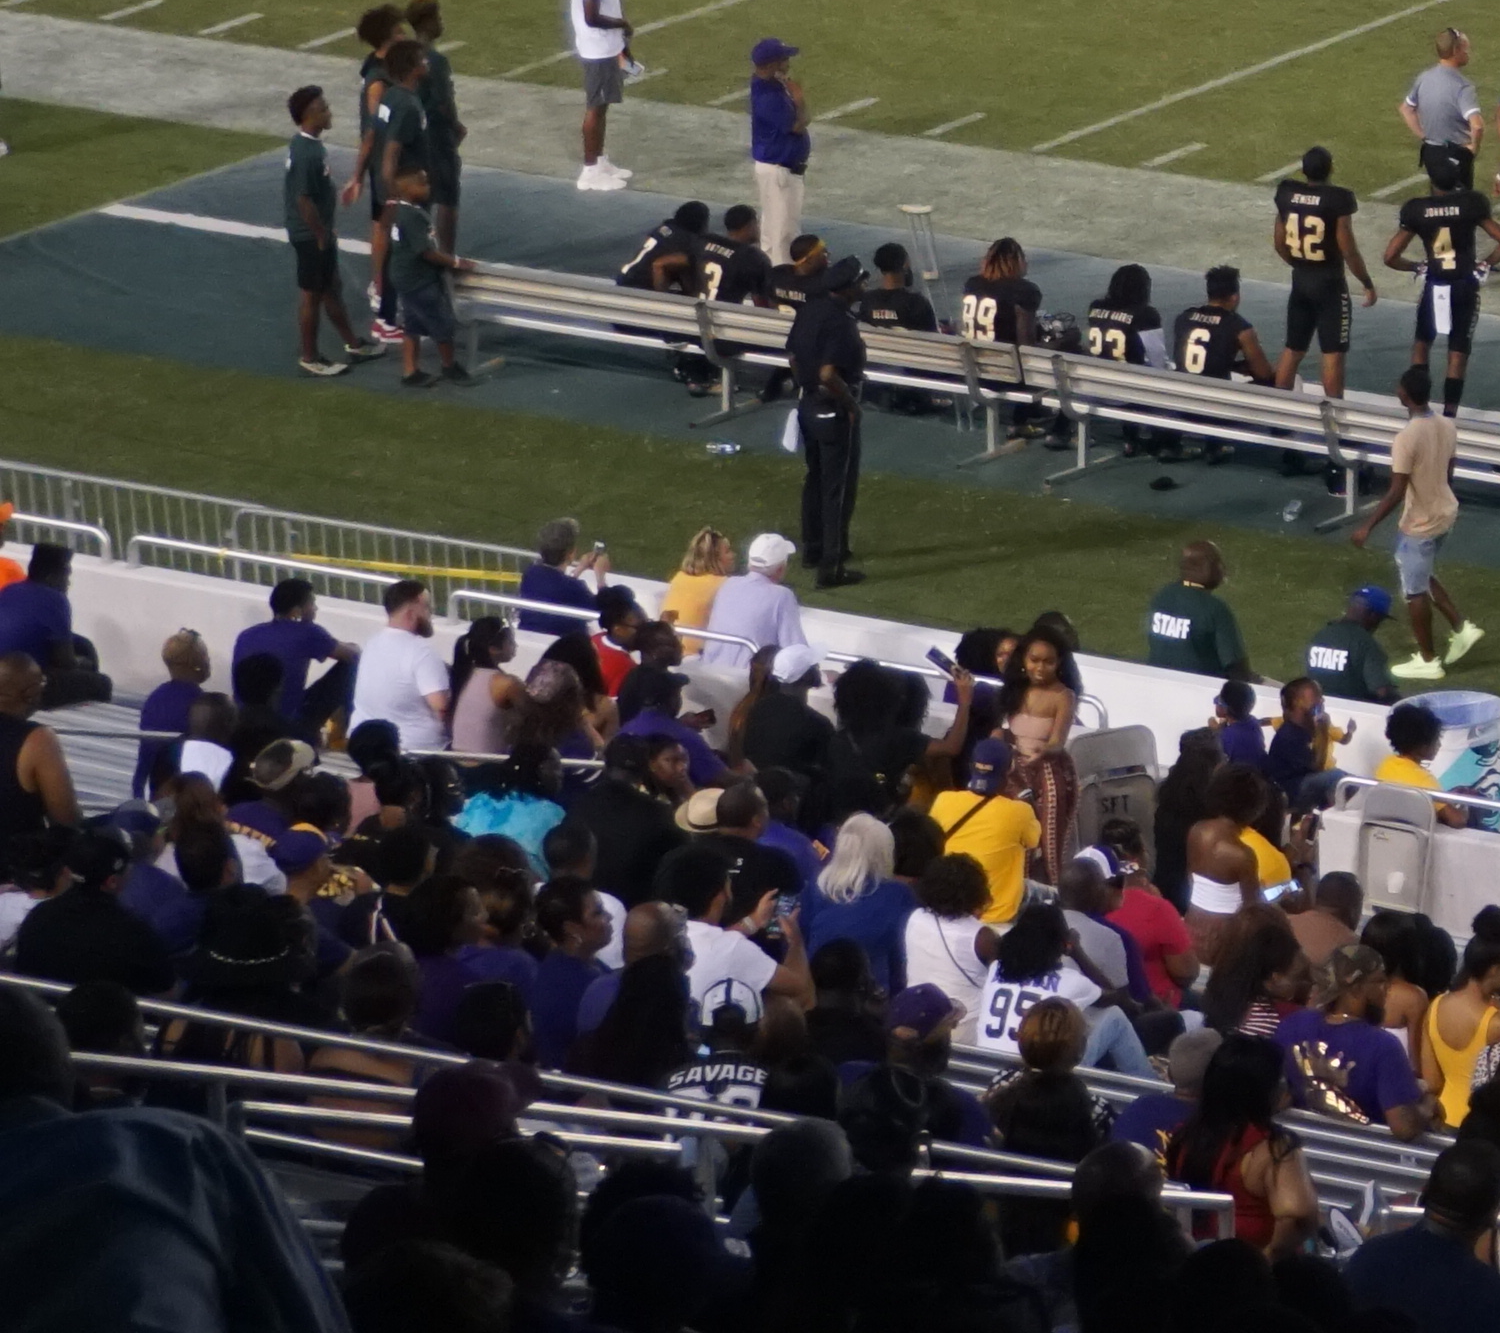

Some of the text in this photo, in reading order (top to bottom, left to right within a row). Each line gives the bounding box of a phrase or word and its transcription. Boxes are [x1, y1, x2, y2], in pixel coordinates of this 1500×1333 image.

[1424, 205, 1460, 218] JOHNSON
[1285, 213, 1326, 262] 42
[1433, 226, 1457, 270] 4
[1185, 329, 1211, 374] 6
[1151, 611, 1191, 640] STAFF
[1308, 645, 1350, 674] STAFF
[668, 1063, 769, 1090] SAVAGE
